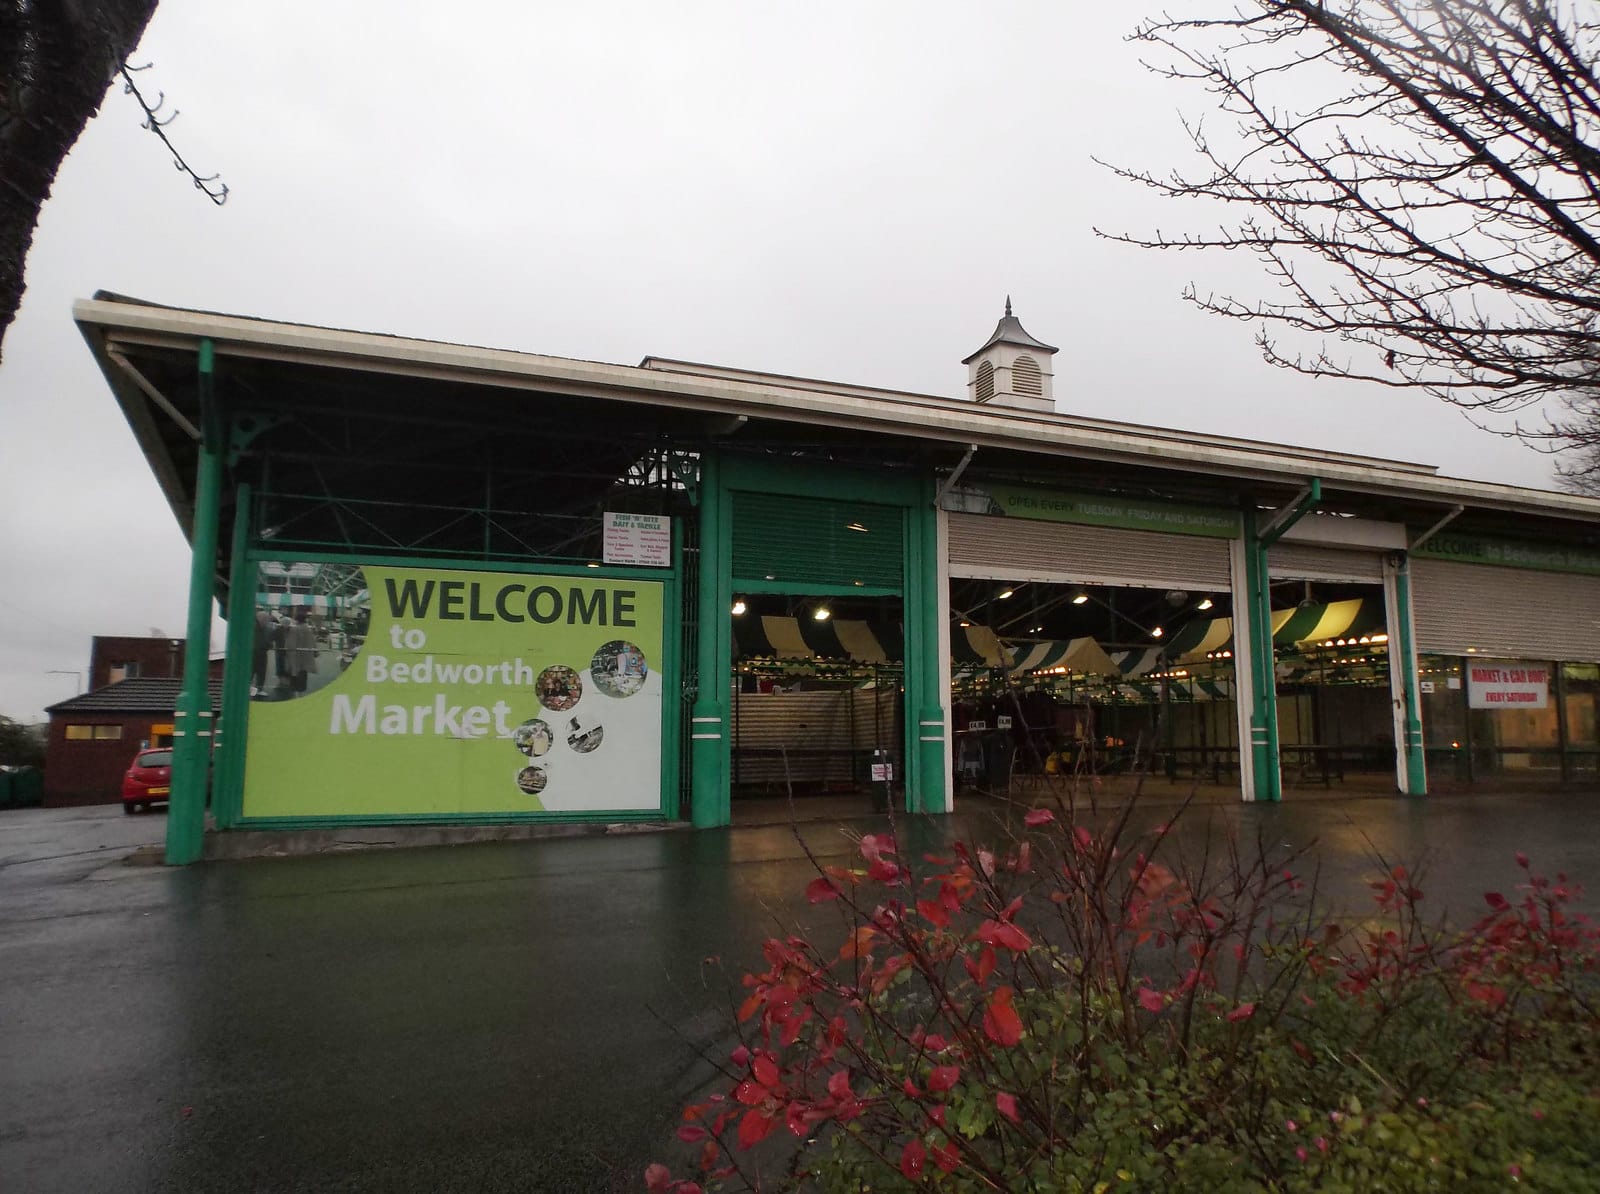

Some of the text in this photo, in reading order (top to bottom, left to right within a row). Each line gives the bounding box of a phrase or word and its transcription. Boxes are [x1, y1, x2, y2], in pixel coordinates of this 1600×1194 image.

[1008, 496, 1038, 510] OPEN
[1041, 499, 1073, 512] EVERY
[1165, 511, 1184, 524] AND
[1187, 514, 1235, 528] SATURDAY
[384, 578, 637, 627] WELCOME
[389, 624, 426, 650] to
[366, 655, 533, 686] Bedworth
[1472, 668, 1499, 682] MARKET
[1502, 671, 1510, 682] &
[1510, 670, 1526, 683] CAR
[1486, 692, 1538, 702] EVERY SATURDAY
[330, 694, 513, 737] Market
